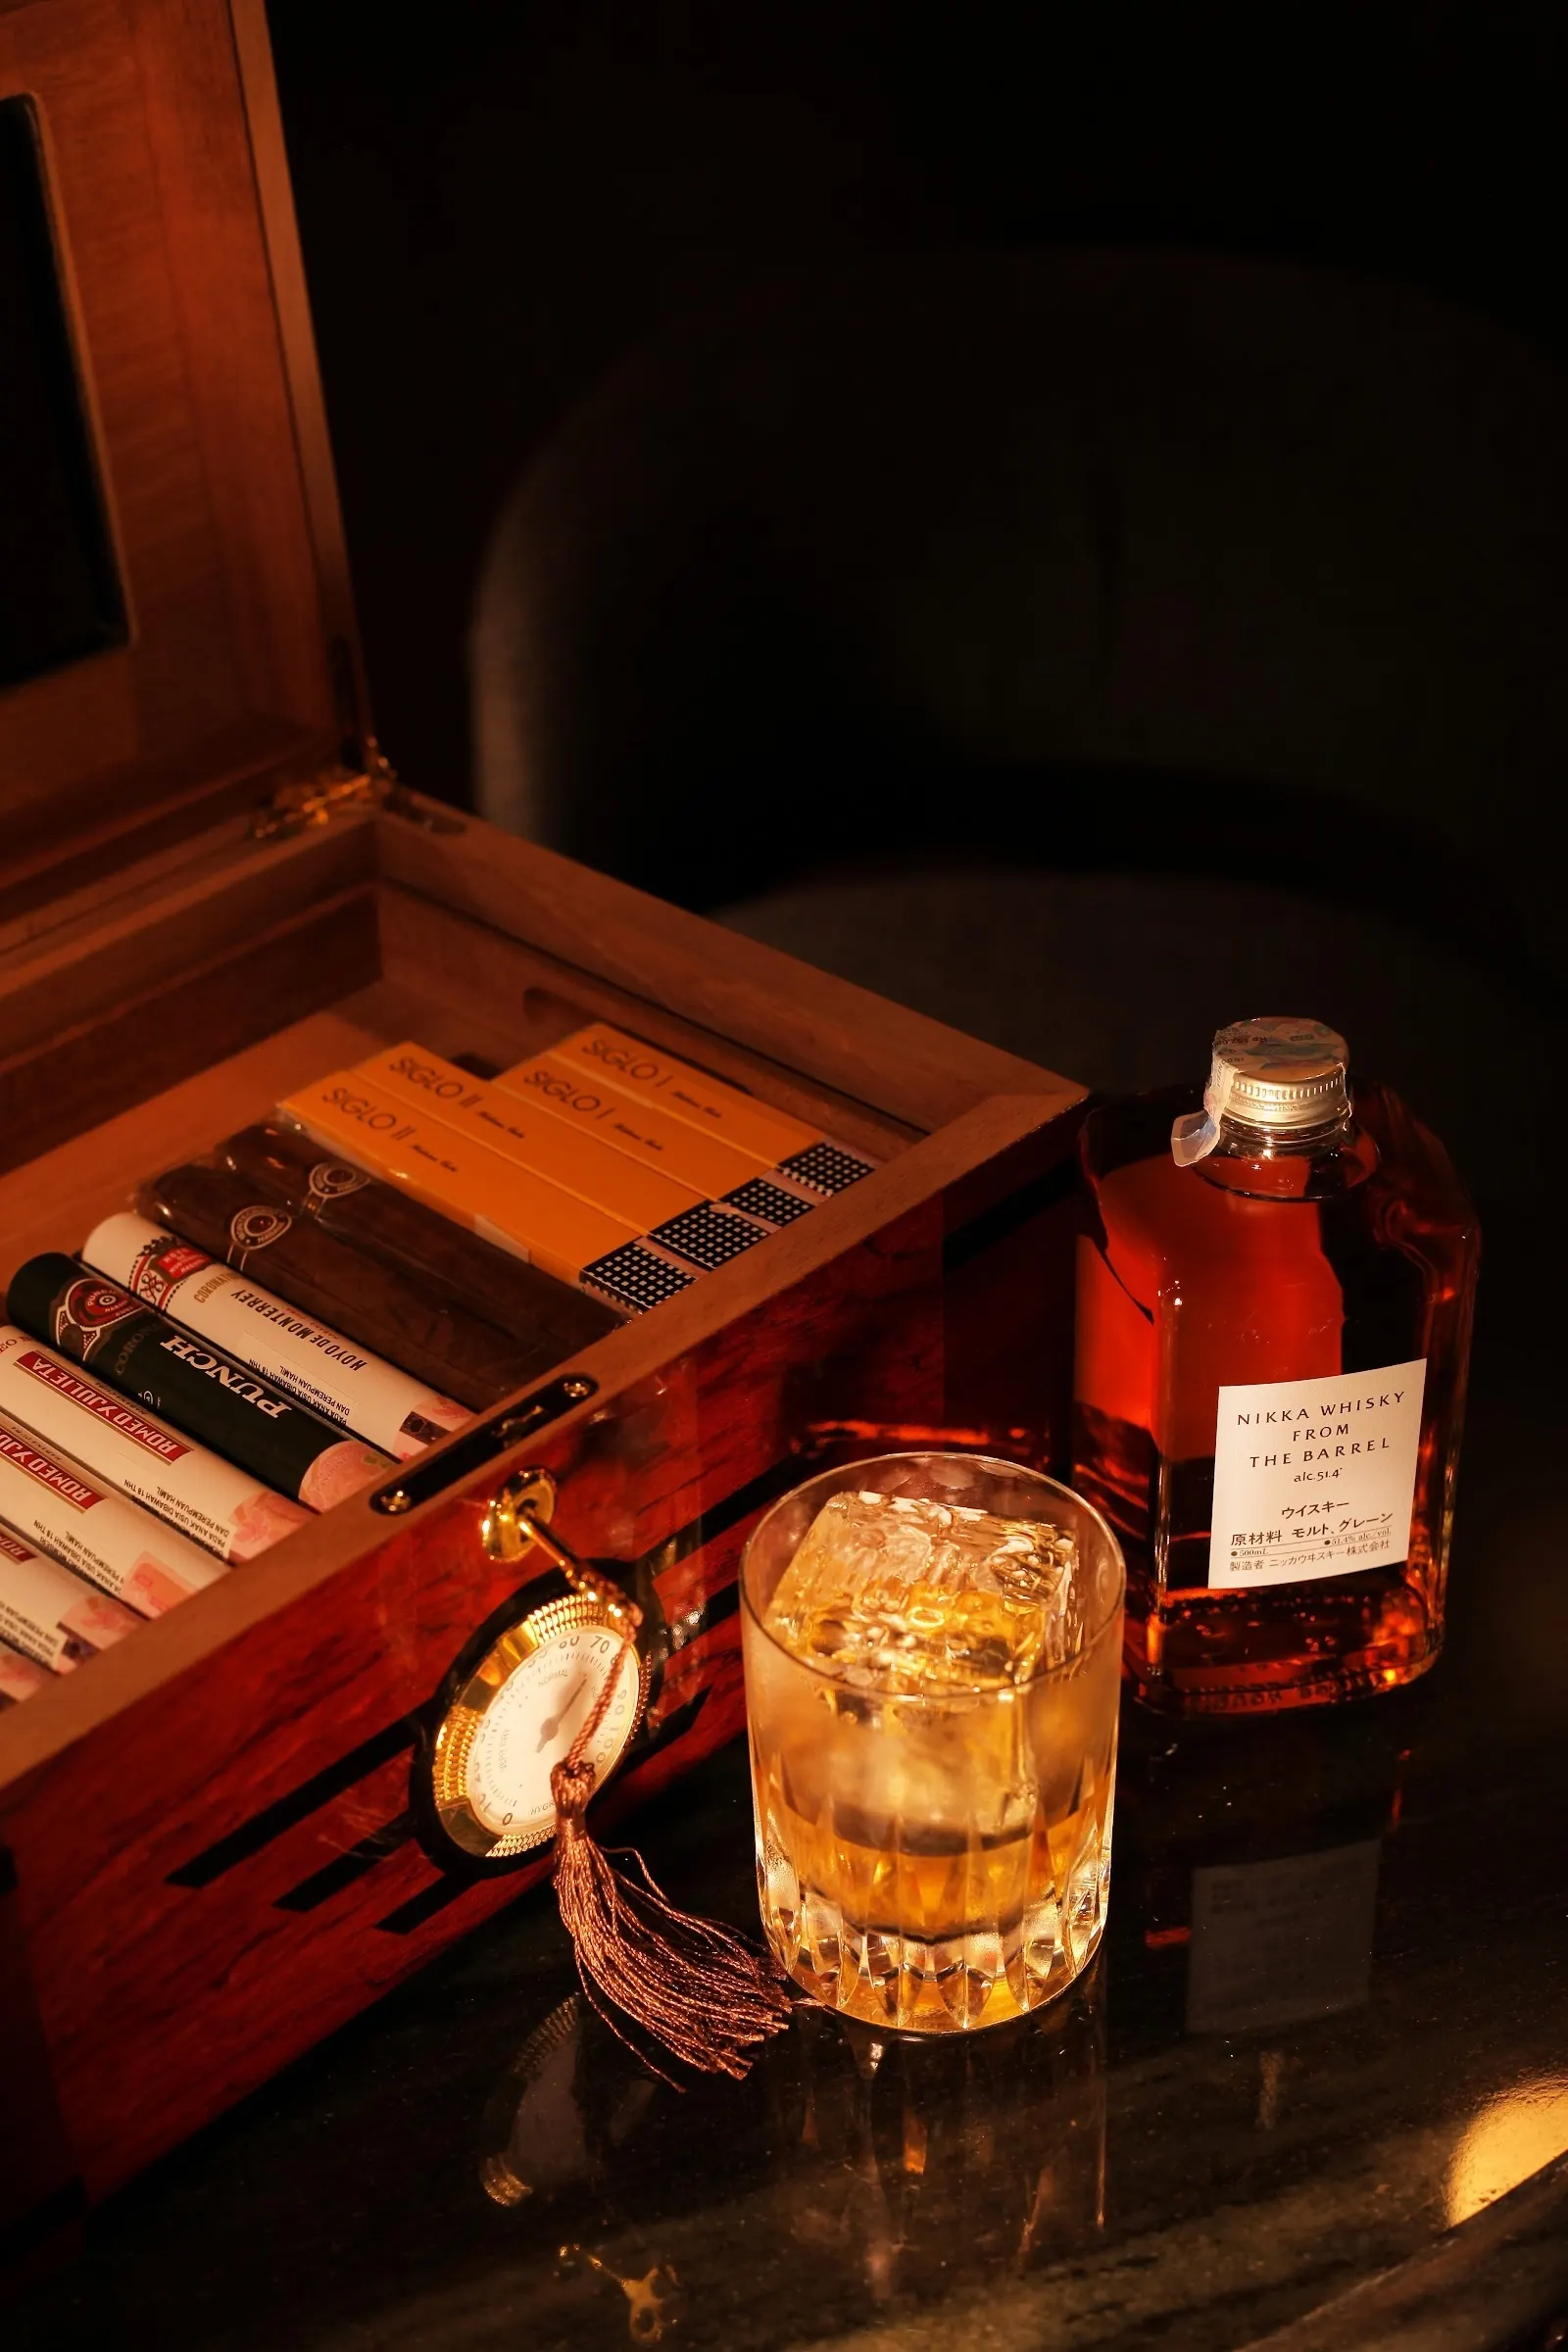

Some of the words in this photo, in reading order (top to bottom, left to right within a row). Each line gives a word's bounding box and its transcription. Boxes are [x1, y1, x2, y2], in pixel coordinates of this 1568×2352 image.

[230, 1289, 315, 1340] MONTERREY
[309, 1335, 326, 1348] DE
[324, 1347, 368, 1372] HOYO
[31, 1357, 108, 1406] JULIETA
[160, 1335, 292, 1419] PUNCH
[299, 1377, 336, 1406] PEREMPUAN
[335, 1402, 350, 1416] DAN
[1238, 1408, 1309, 1426] NIKKA
[1321, 1391, 1405, 1416] WHISKY
[113, 1411, 178, 1454] ROMEO
[1293, 1423, 1349, 1442] FROM
[1250, 1452, 1292, 1468] THE
[1303, 1438, 1390, 1462] BARREL
[27, 1458, 92, 1501] ROMEO
[123, 1479, 137, 1492] THN
[137, 1488, 145, 1496] 18
[157, 1486, 176, 1502] HAMIL
[146, 1493, 174, 1515] DIBAWAH
[1281, 1500, 1349, 1519] ウイスキー
[174, 1511, 190, 1525] USIA
[175, 1499, 216, 1529] PEREMPUAN
[190, 1522, 208, 1536] ANAK
[216, 1524, 229, 1538] DAN
[1231, 1530, 1283, 1546] 原材料
[209, 1532, 225, 1547] PADA
[590, 1636, 610, 1653] 70
